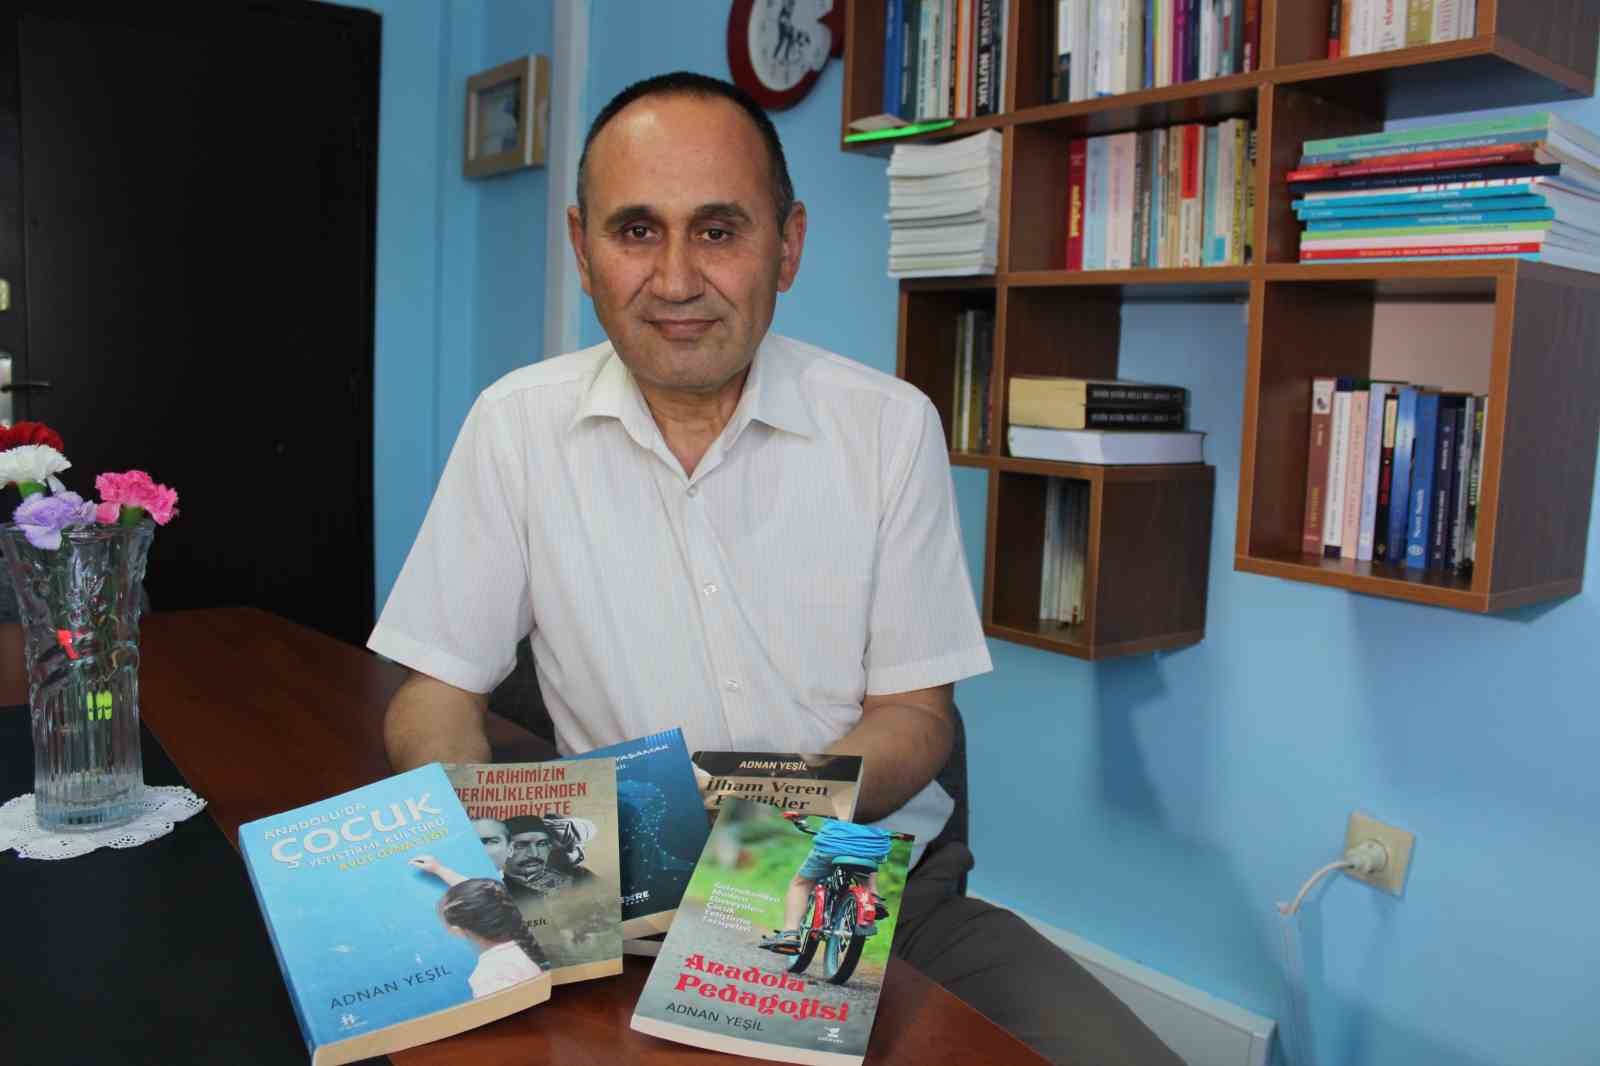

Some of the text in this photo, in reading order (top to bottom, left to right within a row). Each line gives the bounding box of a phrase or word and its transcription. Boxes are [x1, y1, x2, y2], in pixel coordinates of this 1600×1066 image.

[976, 52, 992, 107] NUTUK
[476, 766, 567, 785] TARİHİMİZİN
[740, 760, 808, 772] ADNAN YEŞİL
[704, 777, 829, 797] İlham Veren
[271, 792, 443, 870] ÇOCUK
[331, 981, 399, 1009] ADNAN
[674, 972, 850, 1023] Pedagojisi
[665, 1001, 766, 1032] ADNAN YEŞİL
